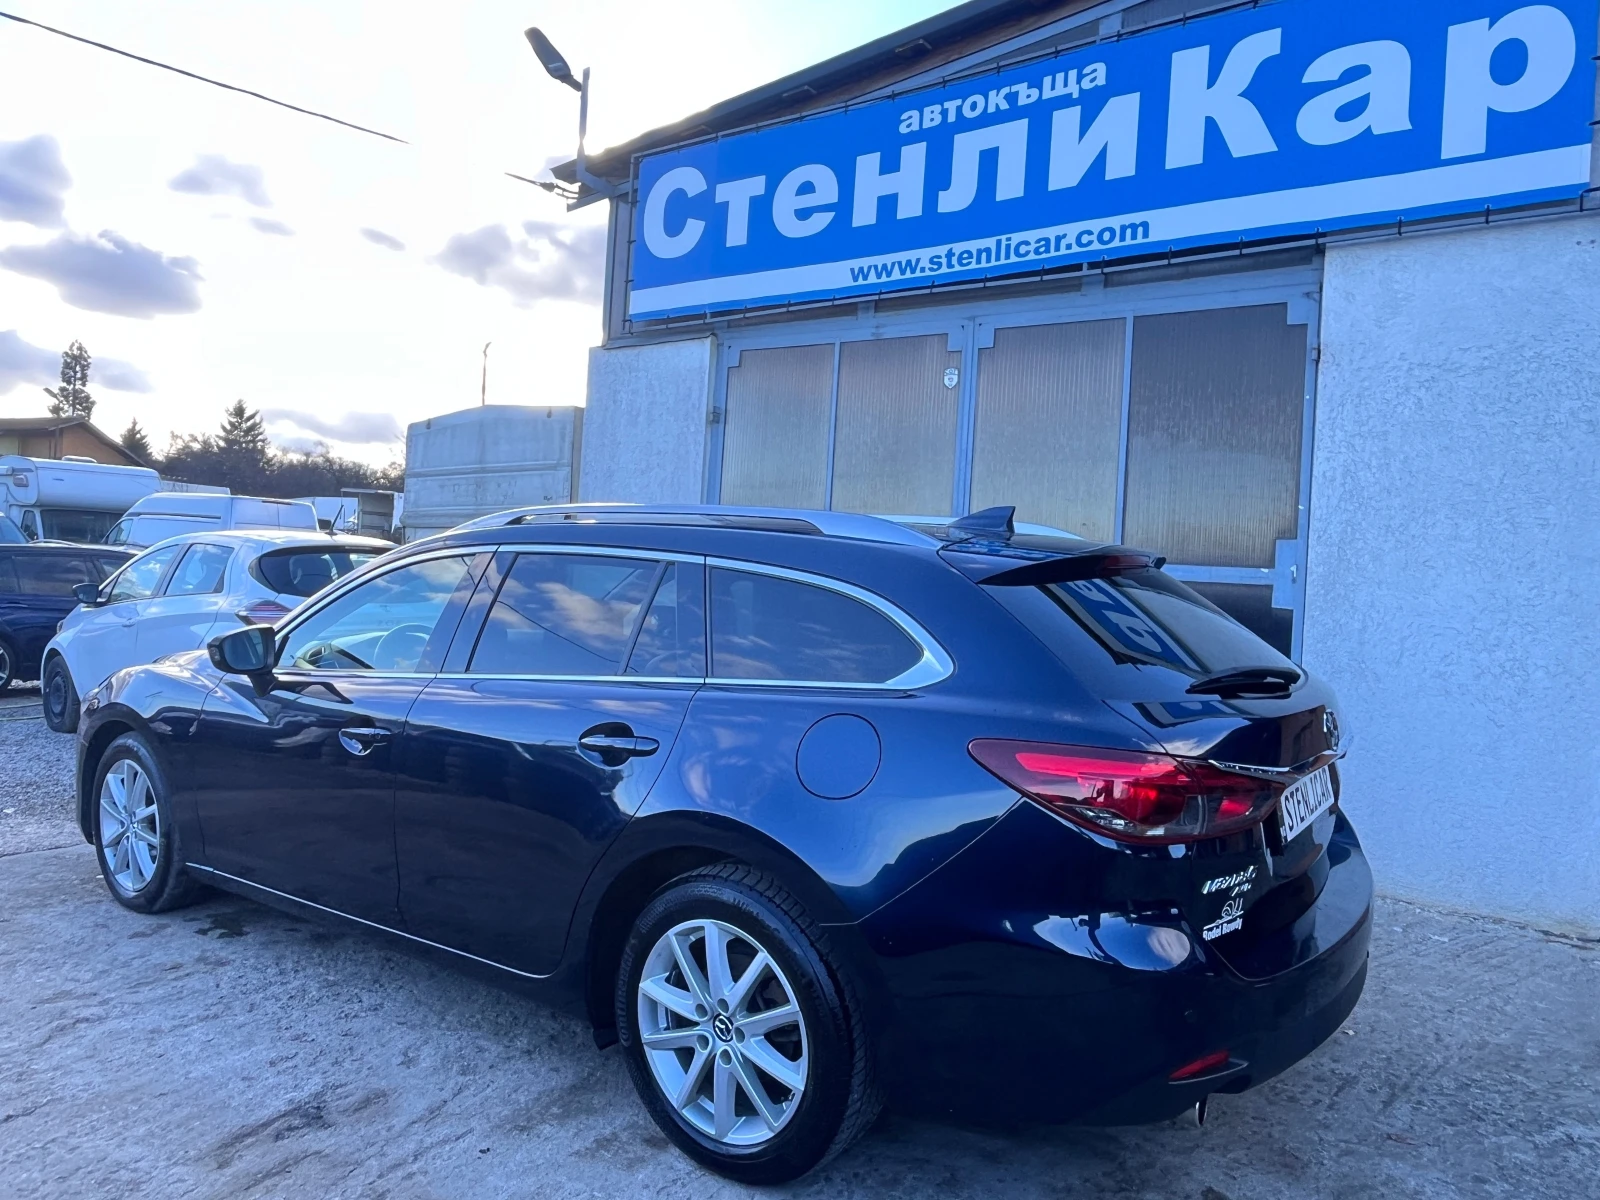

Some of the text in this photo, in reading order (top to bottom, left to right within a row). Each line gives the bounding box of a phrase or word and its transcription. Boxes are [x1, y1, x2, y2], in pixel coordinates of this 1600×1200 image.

[898, 61, 1107, 134] автокъща
[850, 219, 1150, 282] www.stenlicar.com
[1284, 767, 1332, 832] STENLICAR
